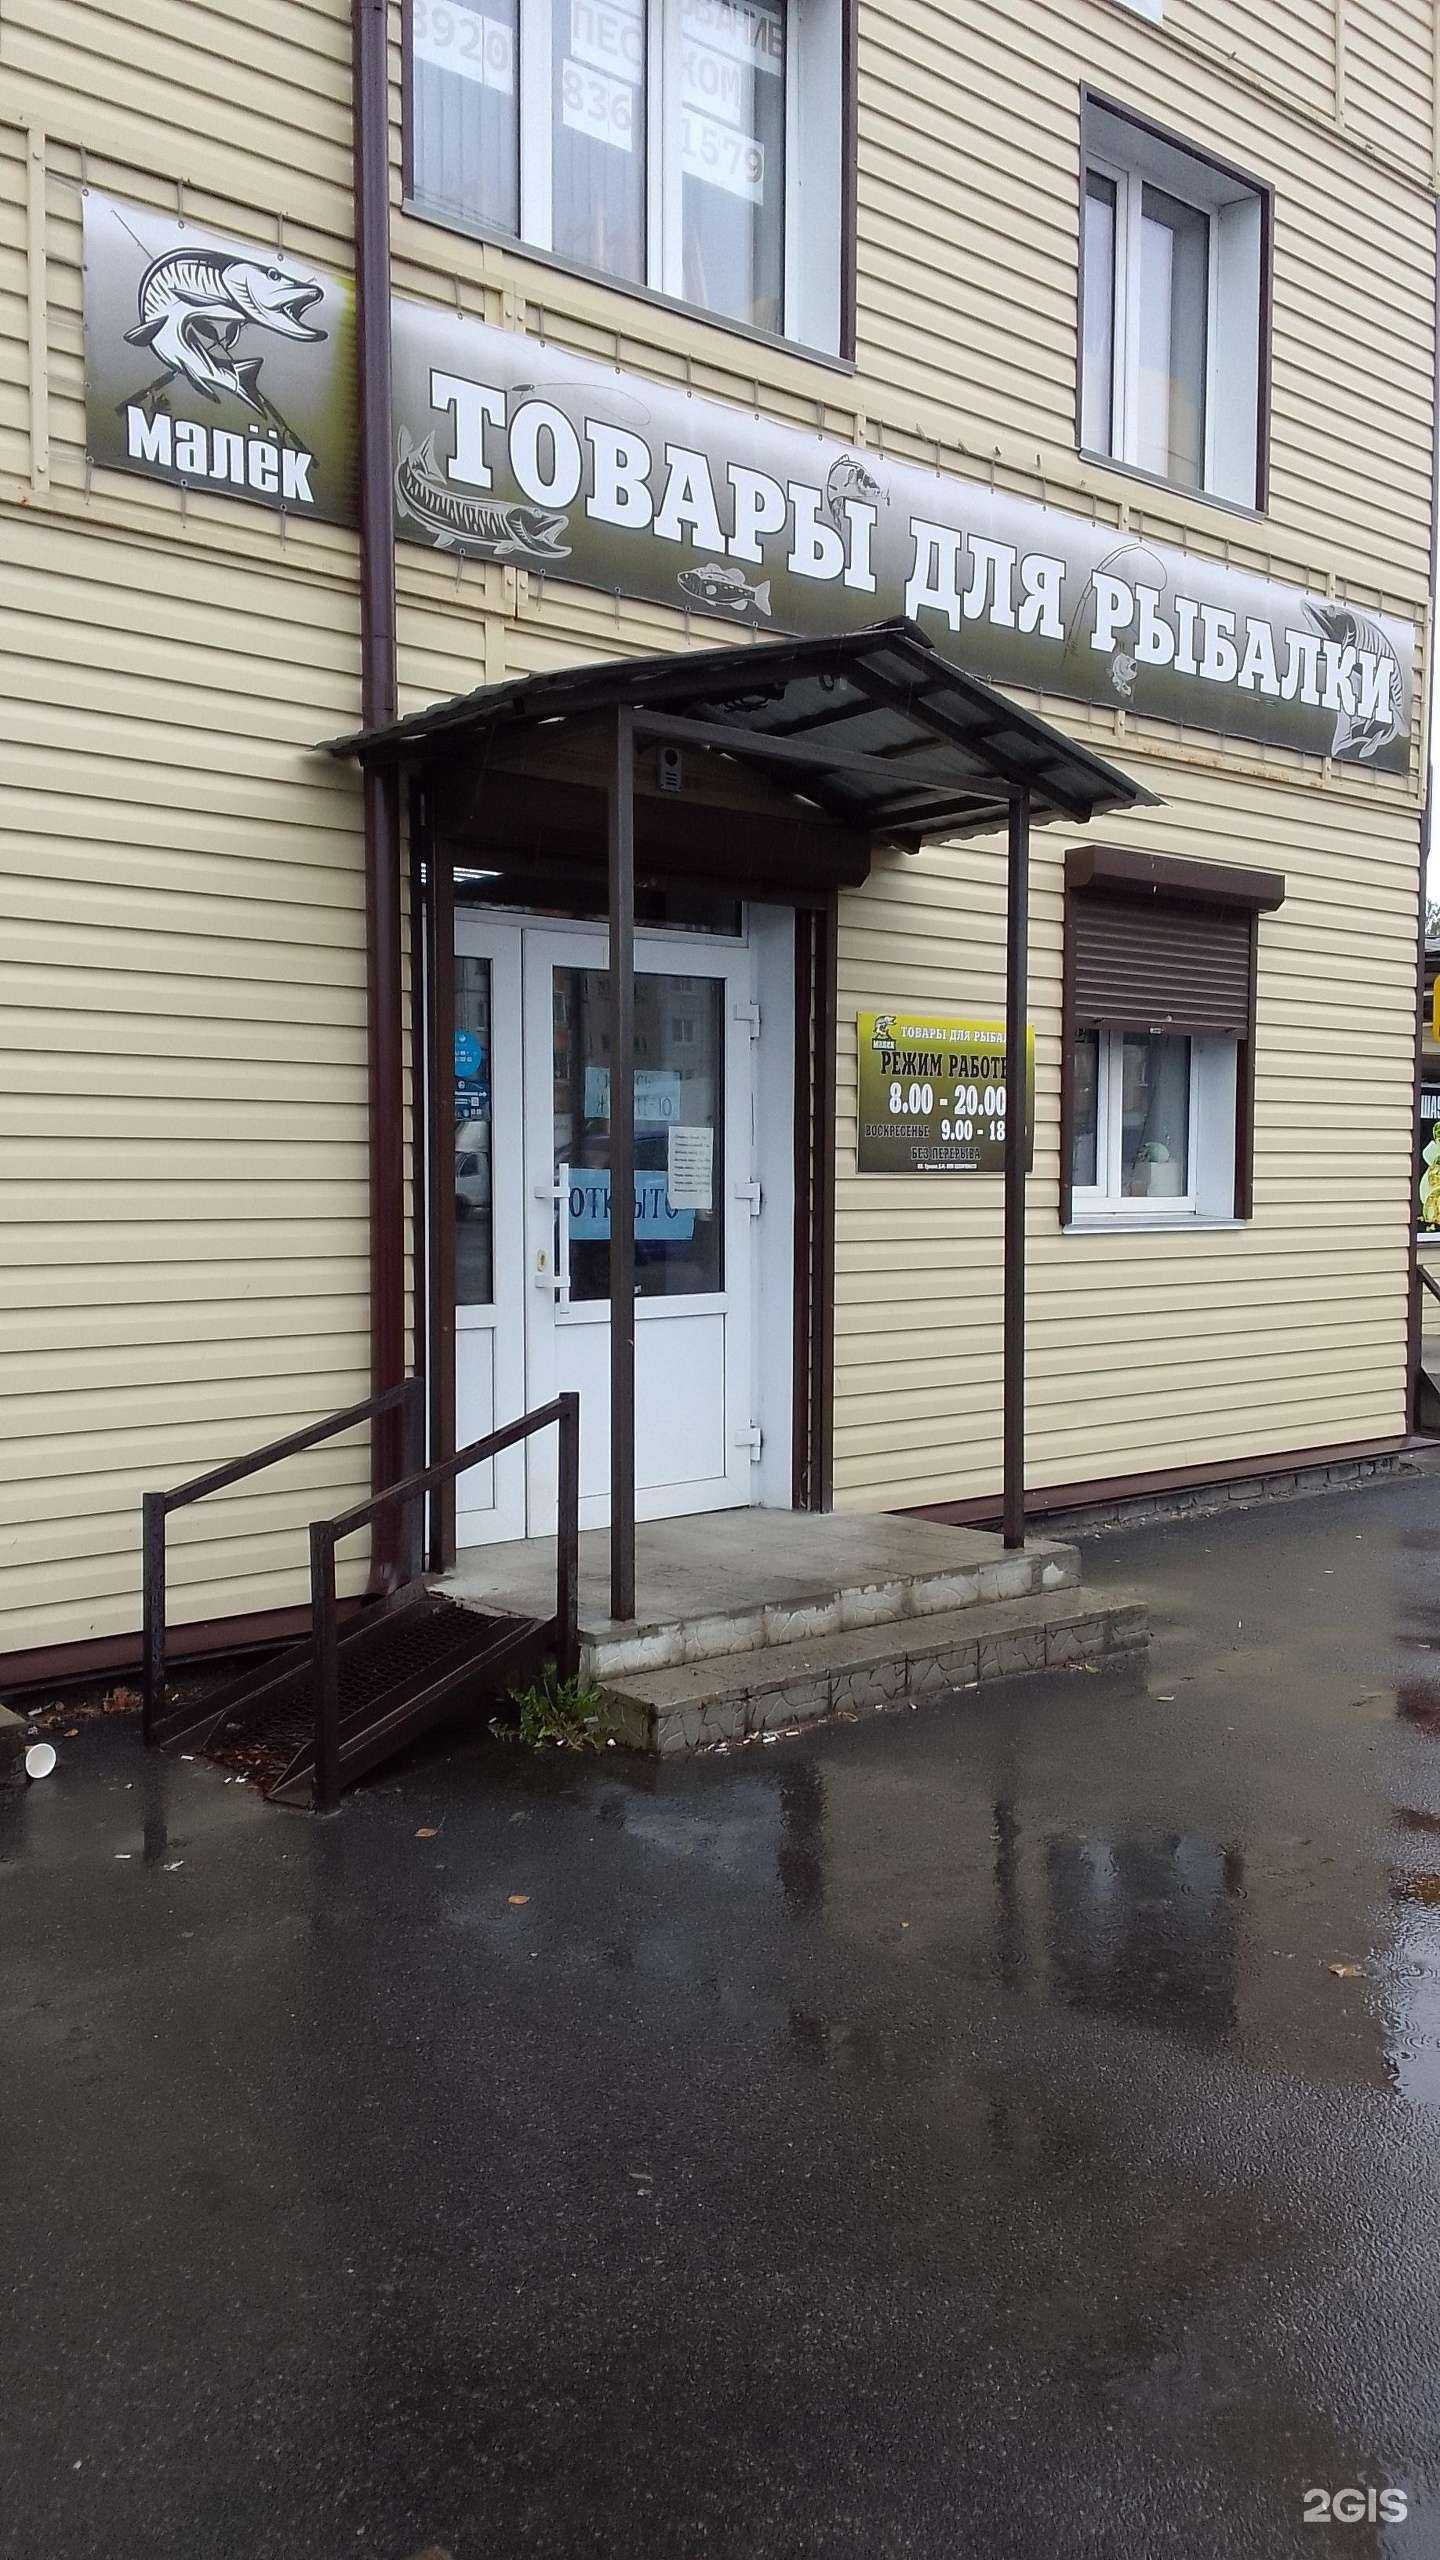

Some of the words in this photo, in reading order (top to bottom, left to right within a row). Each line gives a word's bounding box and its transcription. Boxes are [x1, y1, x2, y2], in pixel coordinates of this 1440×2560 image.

[564, 69, 631, 131] 836
[681, 117, 764, 184] 1579
[429, 368, 878, 594] ТОВАРЫ
[905, 516, 1067, 642] ДЛЯ
[1090, 569, 1395, 722] РЫБАЛКИ
[901, 1026, 947, 1040] ТОВАРЫ
[949, 1029, 971, 1043] ДЛЯ
[881, 1051, 943, 1077] РЕЖИМ
[889, 1082, 934, 1115] 8.00
[954, 1084, 1006, 1117] 20.00
[865, 1124, 930, 1138] ВОСКРЕСЕНЬЕ
[941, 1119, 973, 1141] 9.00
[911, 1146, 929, 1160] БЕЗ
[932, 1147, 981, 1161] ПЕРЕРЫВА
